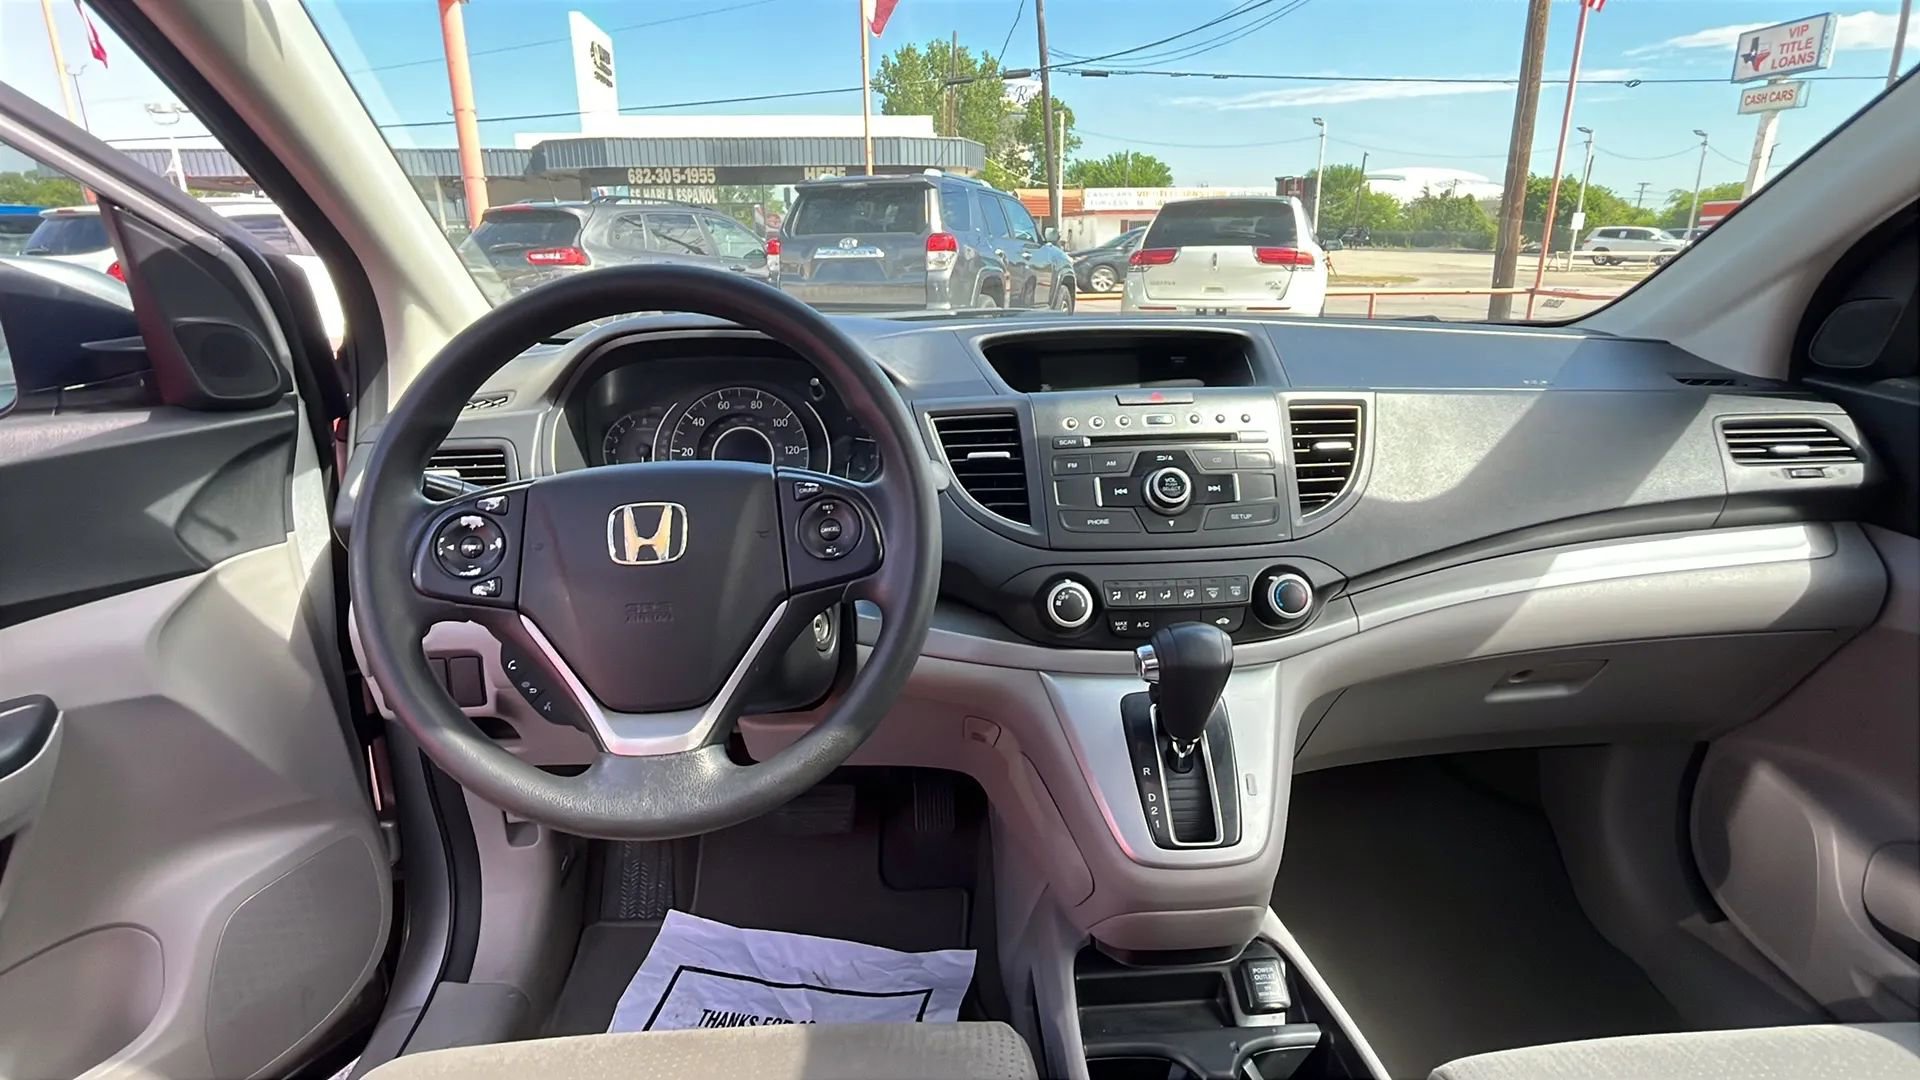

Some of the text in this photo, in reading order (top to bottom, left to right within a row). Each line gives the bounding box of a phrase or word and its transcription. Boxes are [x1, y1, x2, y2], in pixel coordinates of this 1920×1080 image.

[1789, 24, 1810, 39] VIP
[1779, 37, 1814, 55] TITLE
[1771, 51, 1815, 70] LOANS
[1744, 89, 1794, 106] CASH CARS
[627, 167, 717, 185] 682-305-1955
[676, 186, 718, 204] ESPAÑOL
[718, 400, 730, 410] 60
[750, 400, 763, 410] 80
[692, 417, 705, 427] 40
[772, 417, 788, 428] 100
[681, 446, 694, 457] 20
[784, 445, 800, 455] 120
[1087, 518, 1110, 526] PHONE
[1143, 767, 1151, 776] R
[1148, 793, 1156, 802] D
[1151, 806, 1158, 815] 2
[1155, 820, 1160, 829] 1
[698, 1008, 760, 1028] THANKS
